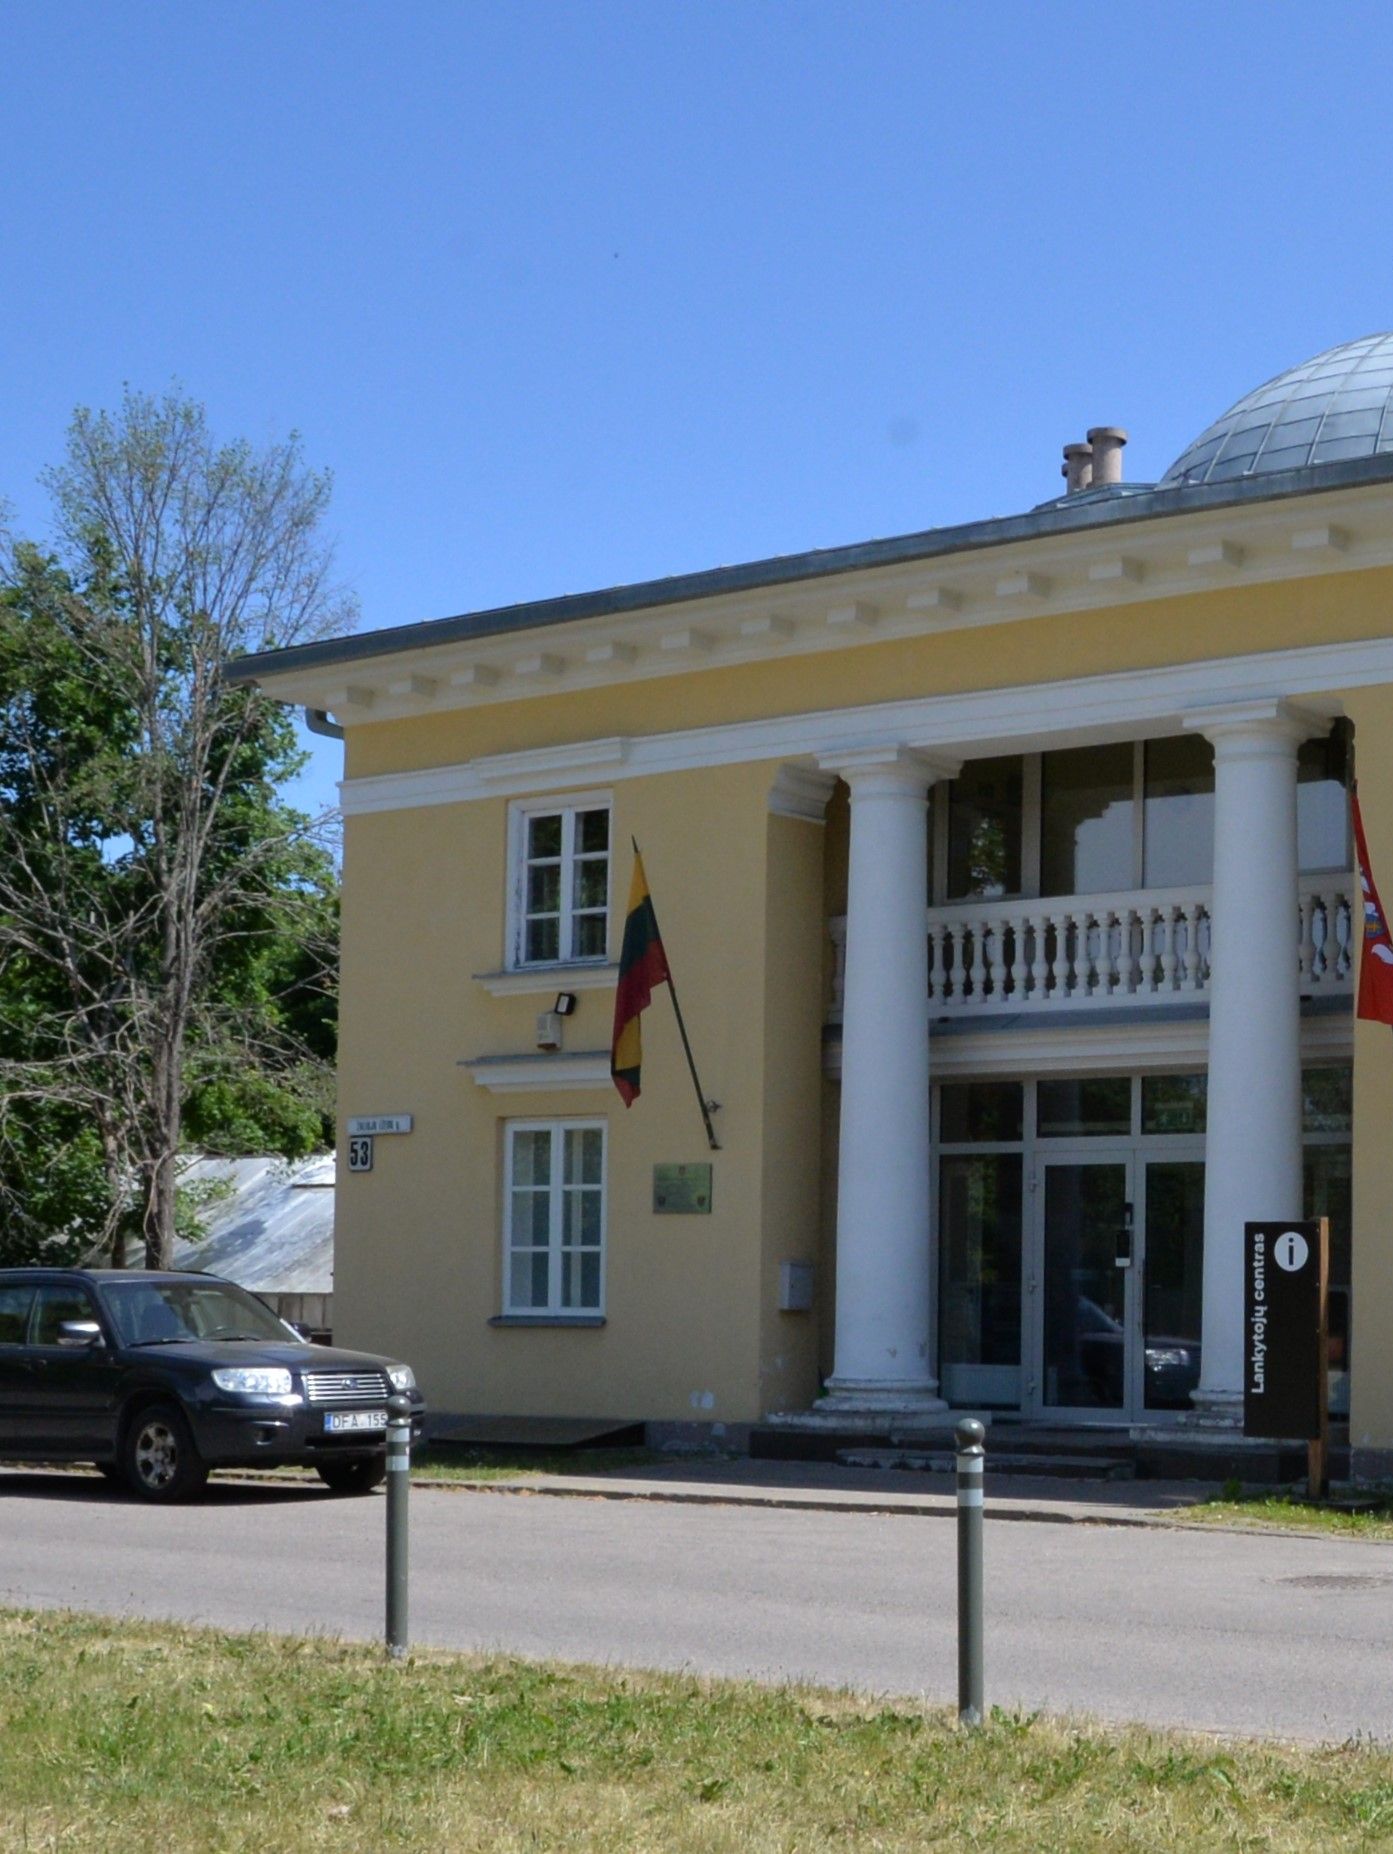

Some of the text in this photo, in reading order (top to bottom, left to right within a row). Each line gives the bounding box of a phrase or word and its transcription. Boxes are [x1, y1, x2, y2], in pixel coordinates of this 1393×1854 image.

[350, 1141, 369, 1167] 53
[1251, 1232, 1268, 1394] Lankytojų centras
